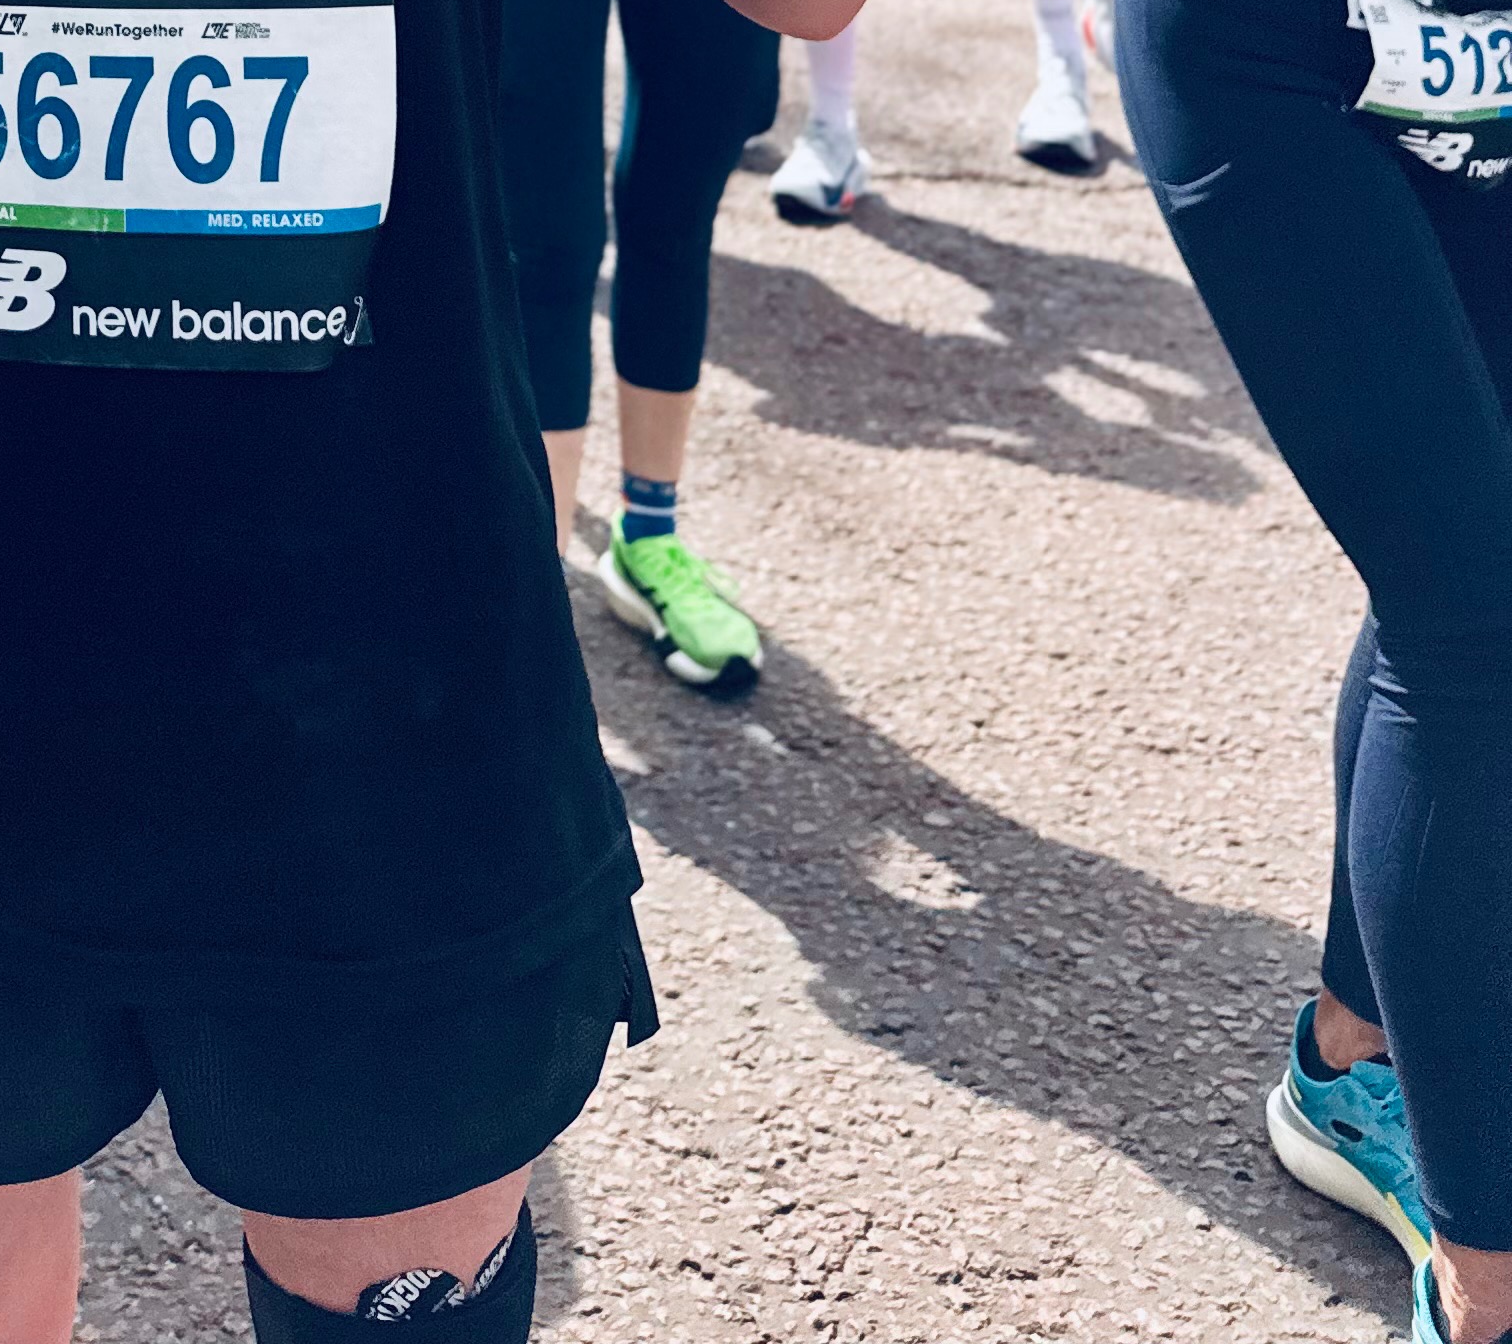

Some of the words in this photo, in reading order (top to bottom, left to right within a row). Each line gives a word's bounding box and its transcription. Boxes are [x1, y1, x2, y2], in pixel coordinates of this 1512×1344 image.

[51, 22, 184, 40] #WeRunTogether
[252, 212, 324, 228] RELAXED
[73, 302, 161, 339] new
[172, 299, 347, 342] balance
